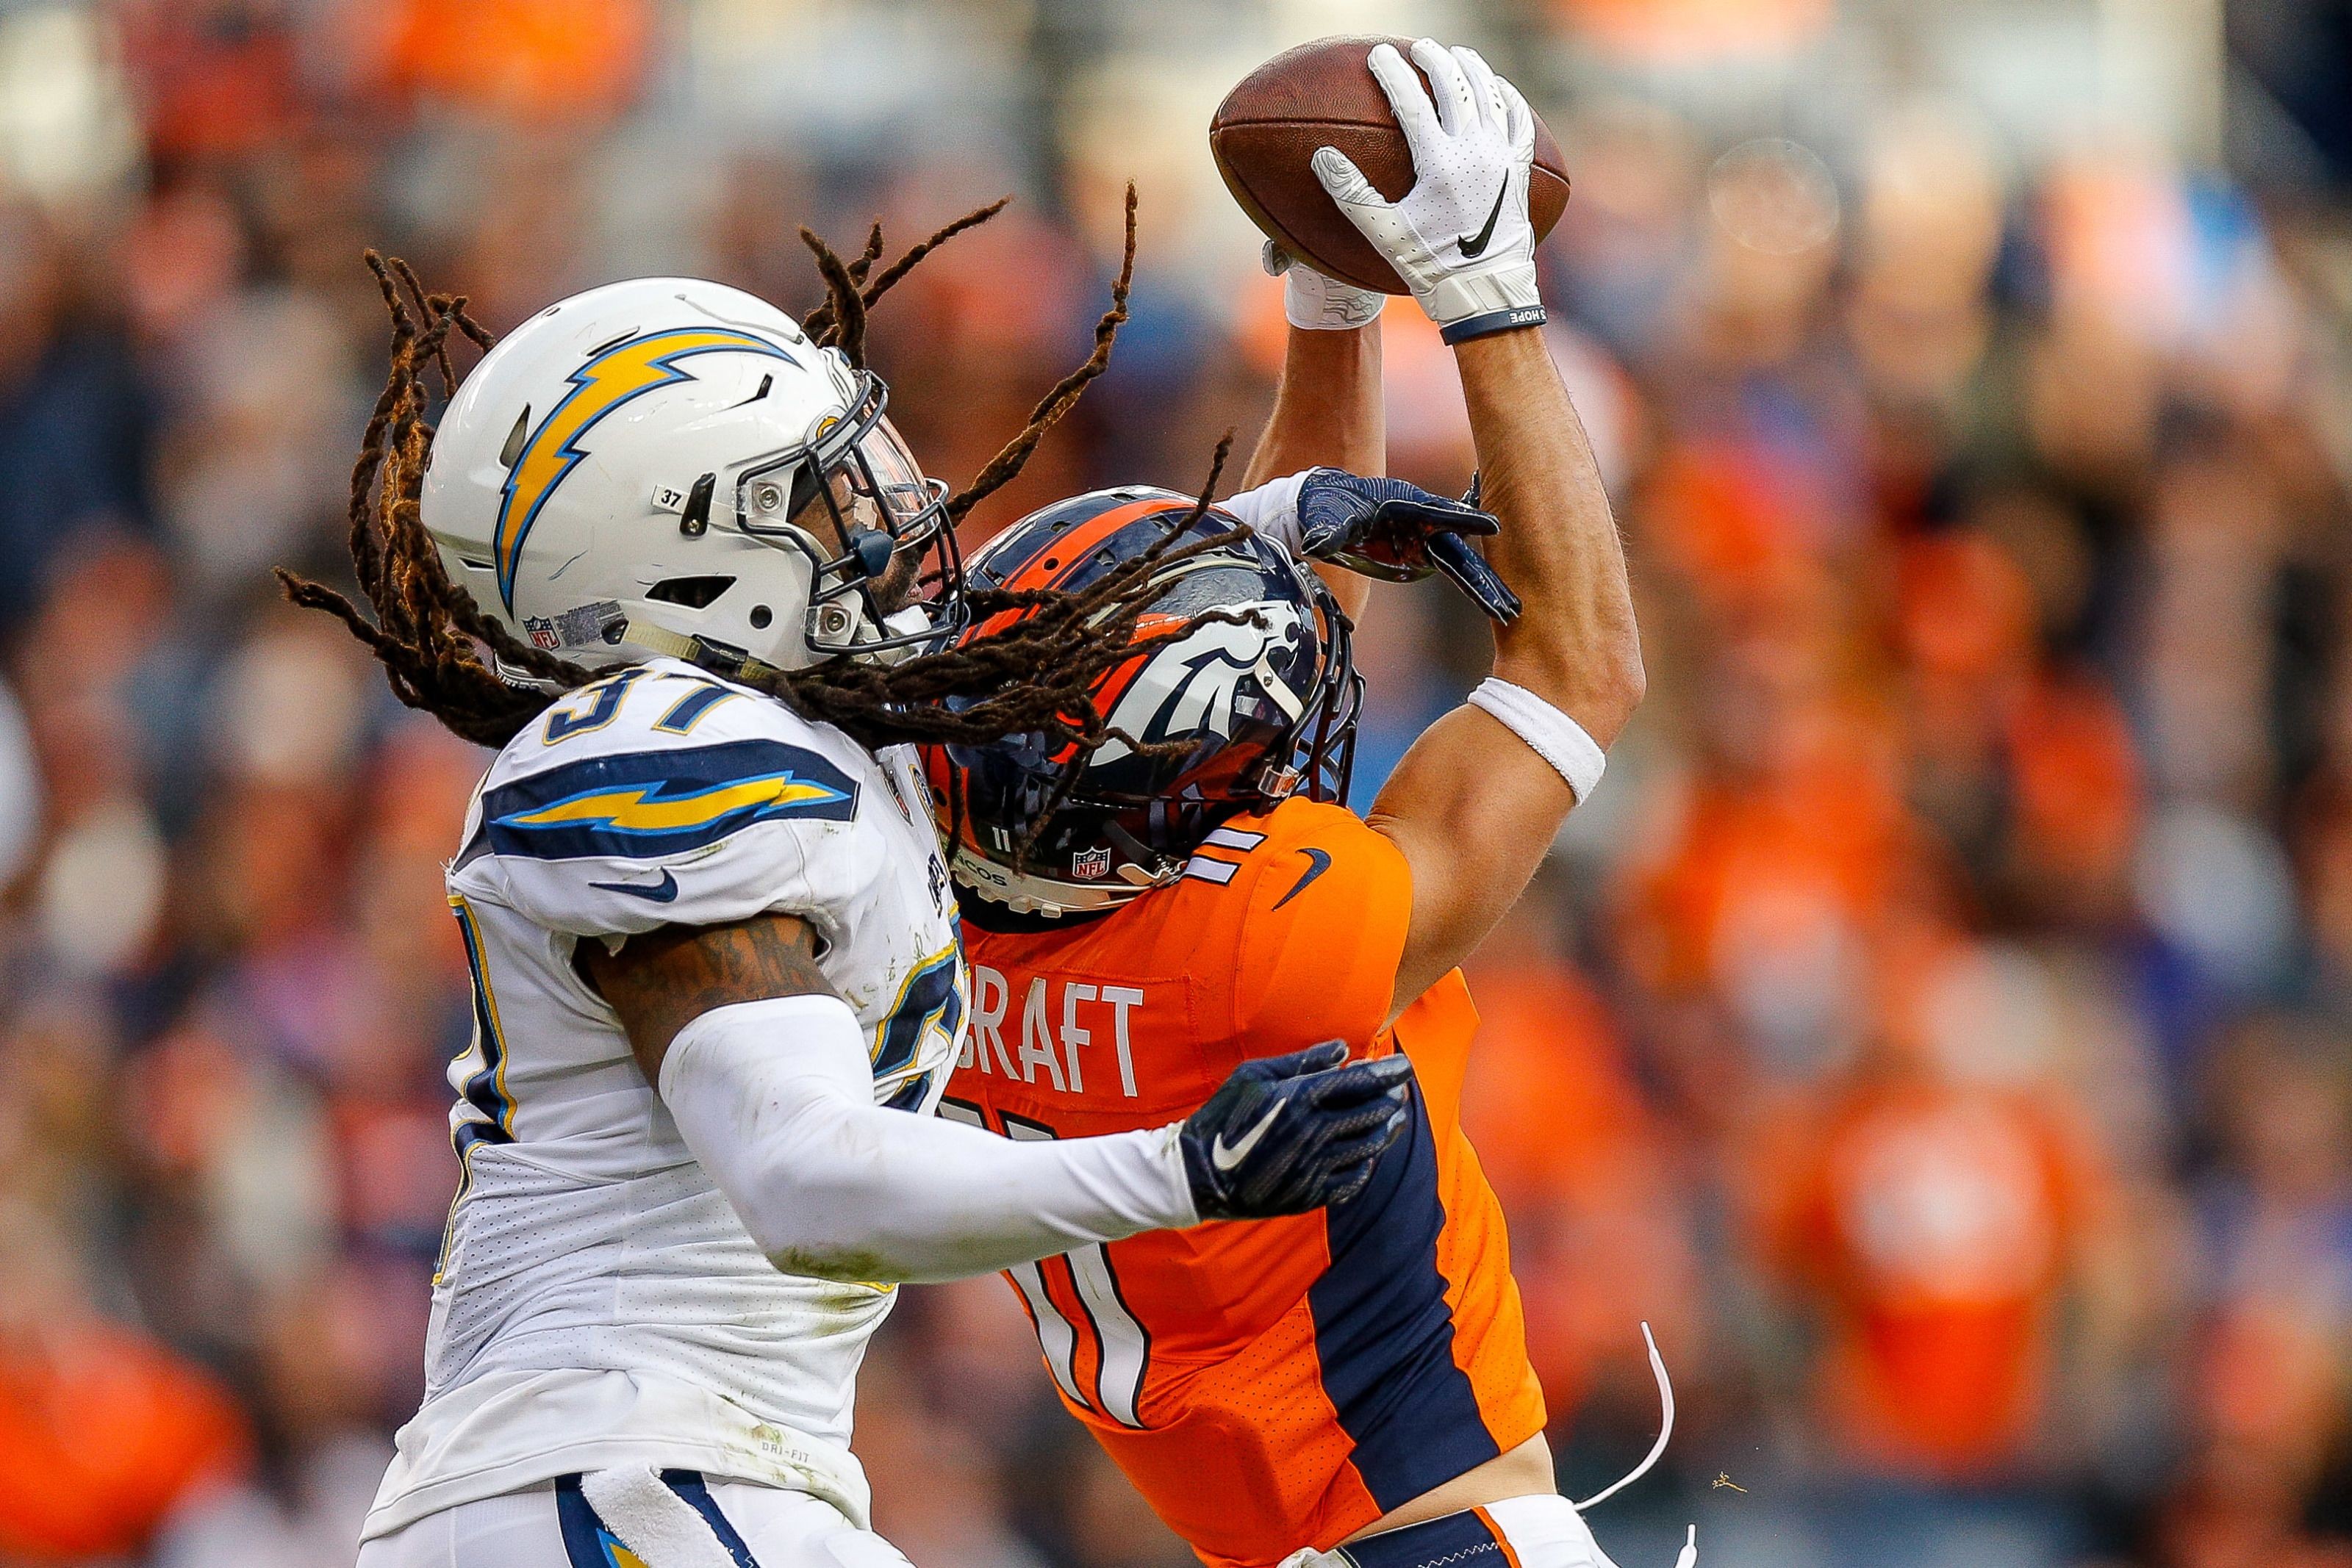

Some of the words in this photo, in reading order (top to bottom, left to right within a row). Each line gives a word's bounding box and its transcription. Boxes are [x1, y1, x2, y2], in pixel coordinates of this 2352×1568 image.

[1510, 309, 1541, 323] HOPE
[661, 489, 682, 507] 37
[542, 666, 755, 745] 37
[992, 826, 1011, 852] 11
[957, 964, 1144, 1098] RAFT
[761, 1442, 810, 1463] DRI-FIT
